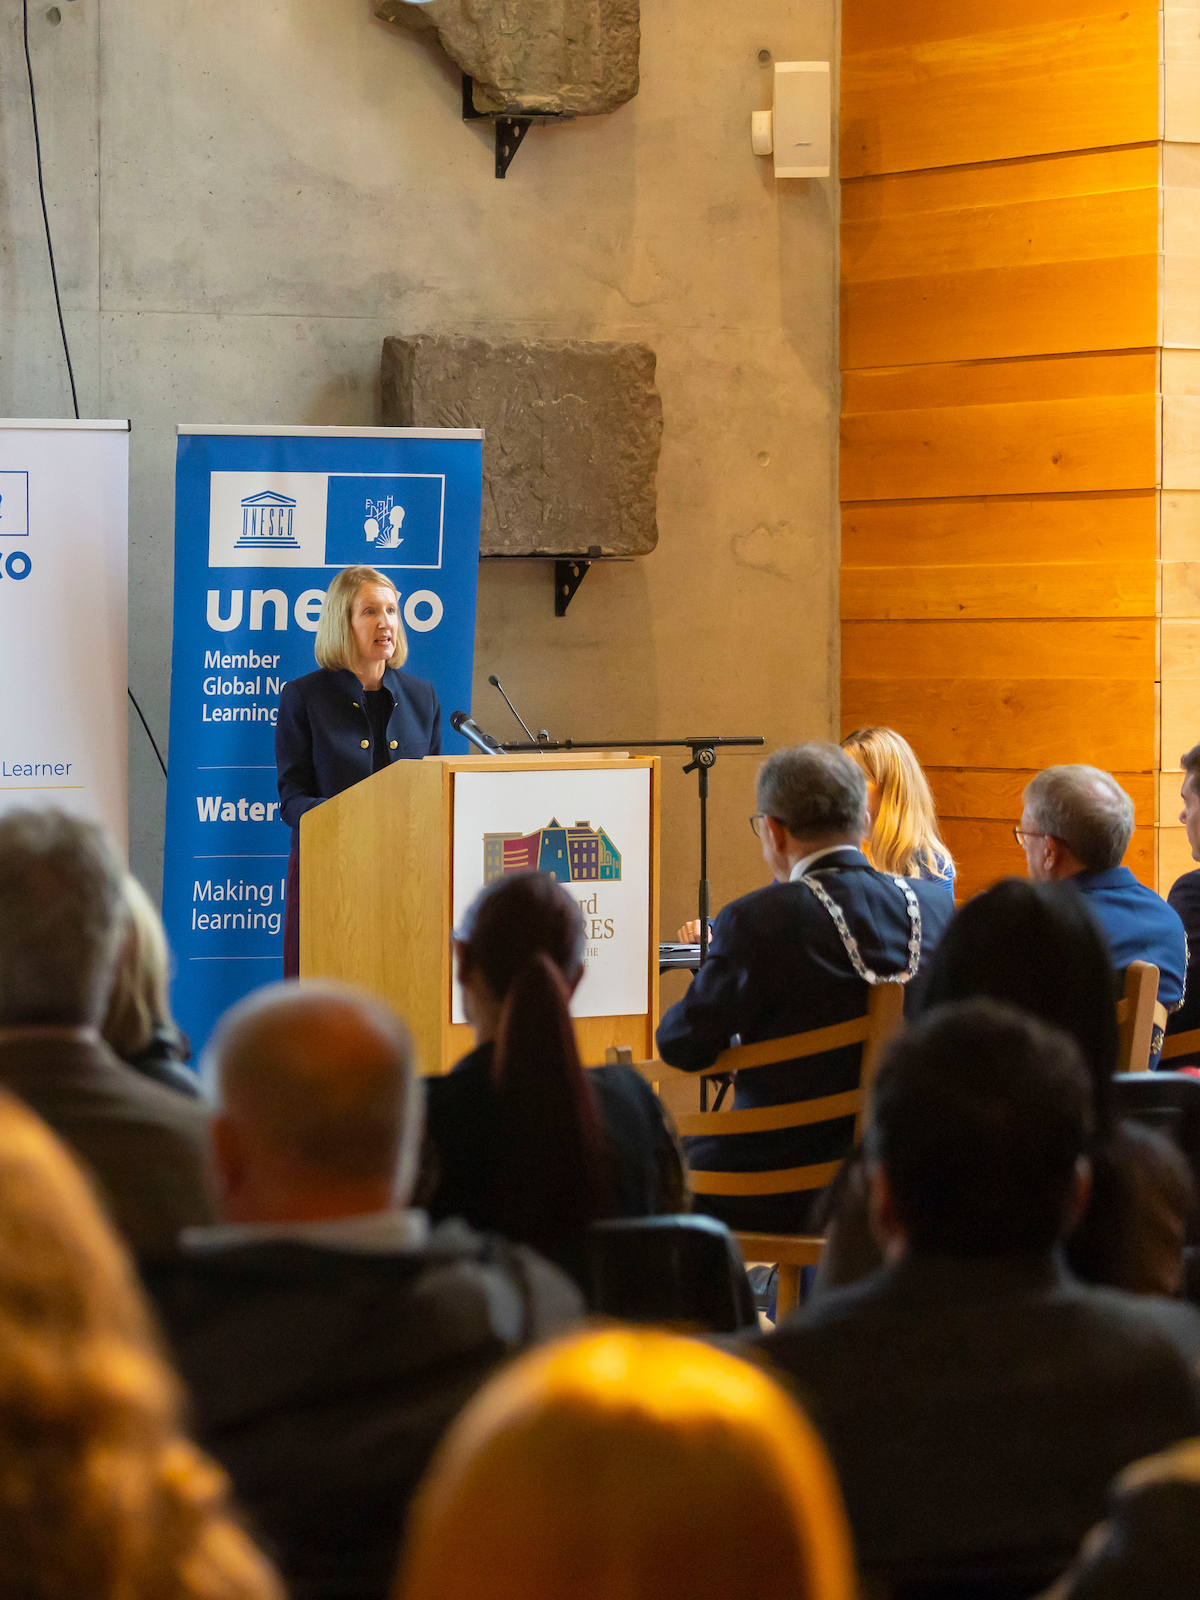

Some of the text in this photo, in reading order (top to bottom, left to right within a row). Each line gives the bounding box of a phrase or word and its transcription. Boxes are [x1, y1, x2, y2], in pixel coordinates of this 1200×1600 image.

[242, 508, 294, 536] UNESCO
[206, 588, 444, 633] uneo
[204, 649, 280, 669] Member
[203, 676, 260, 695] Global
[202, 703, 279, 726] Learning
[196, 796, 283, 823] Water
[193, 879, 274, 907] Making
[191, 908, 282, 935] learning
